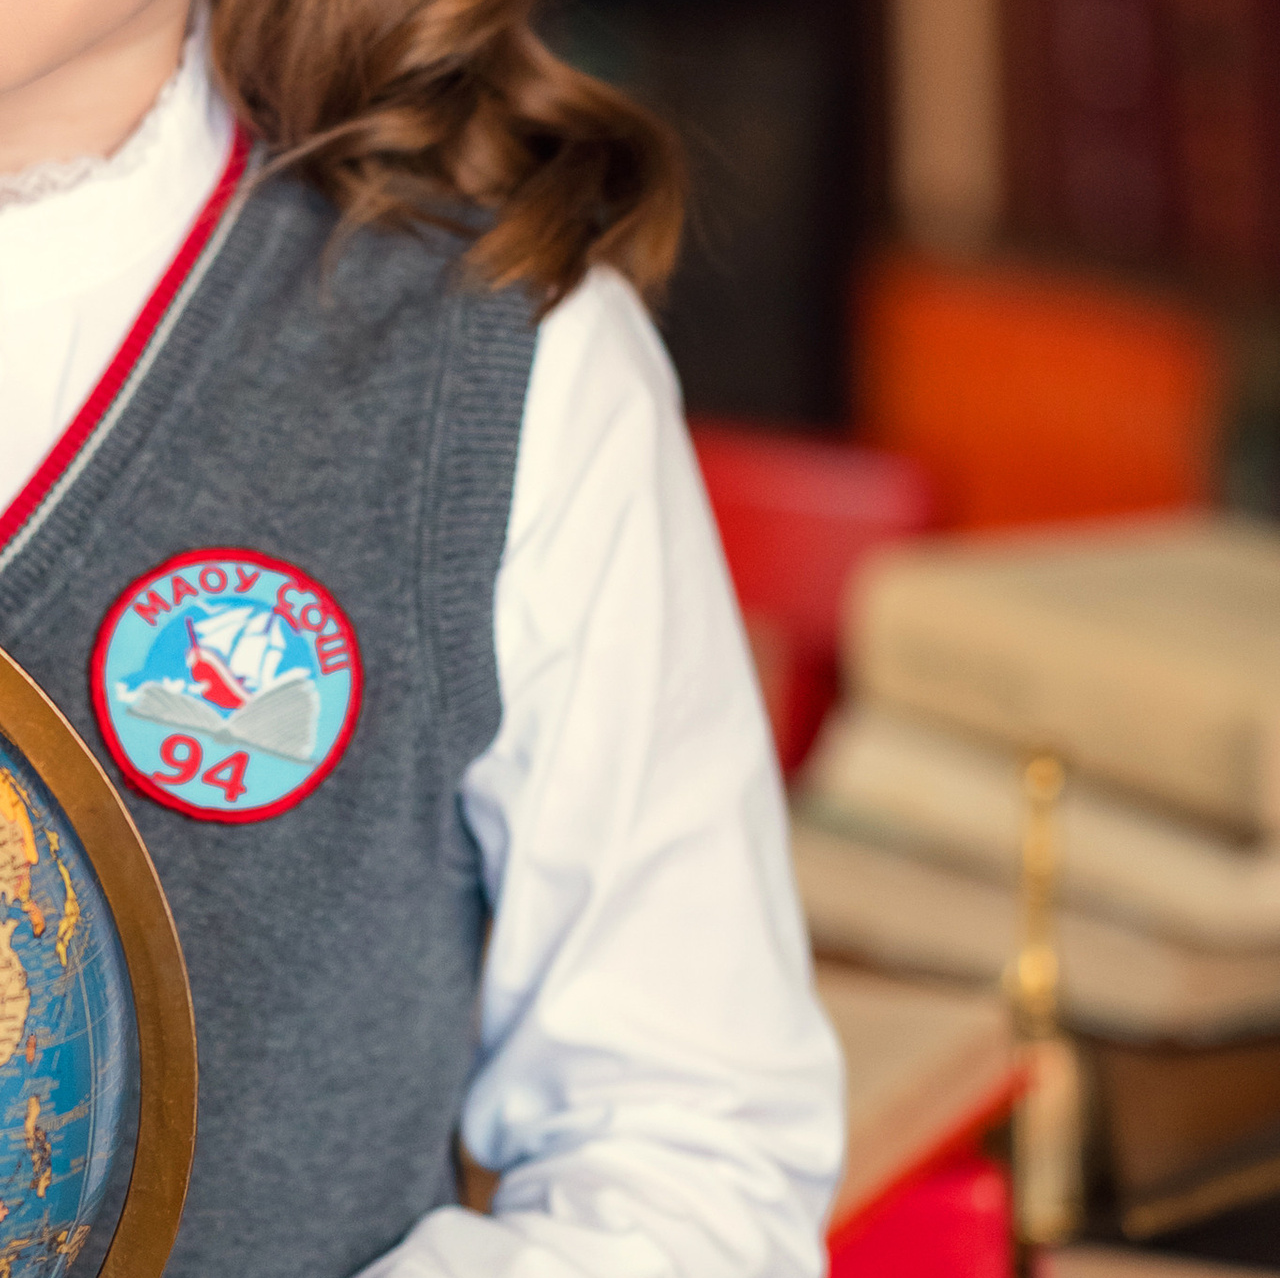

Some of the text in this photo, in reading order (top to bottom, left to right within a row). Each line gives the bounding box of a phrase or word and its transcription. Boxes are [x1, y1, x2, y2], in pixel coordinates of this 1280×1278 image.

[133, 566, 352, 676] МАОУ СОШ
[152, 733, 250, 803] 94
